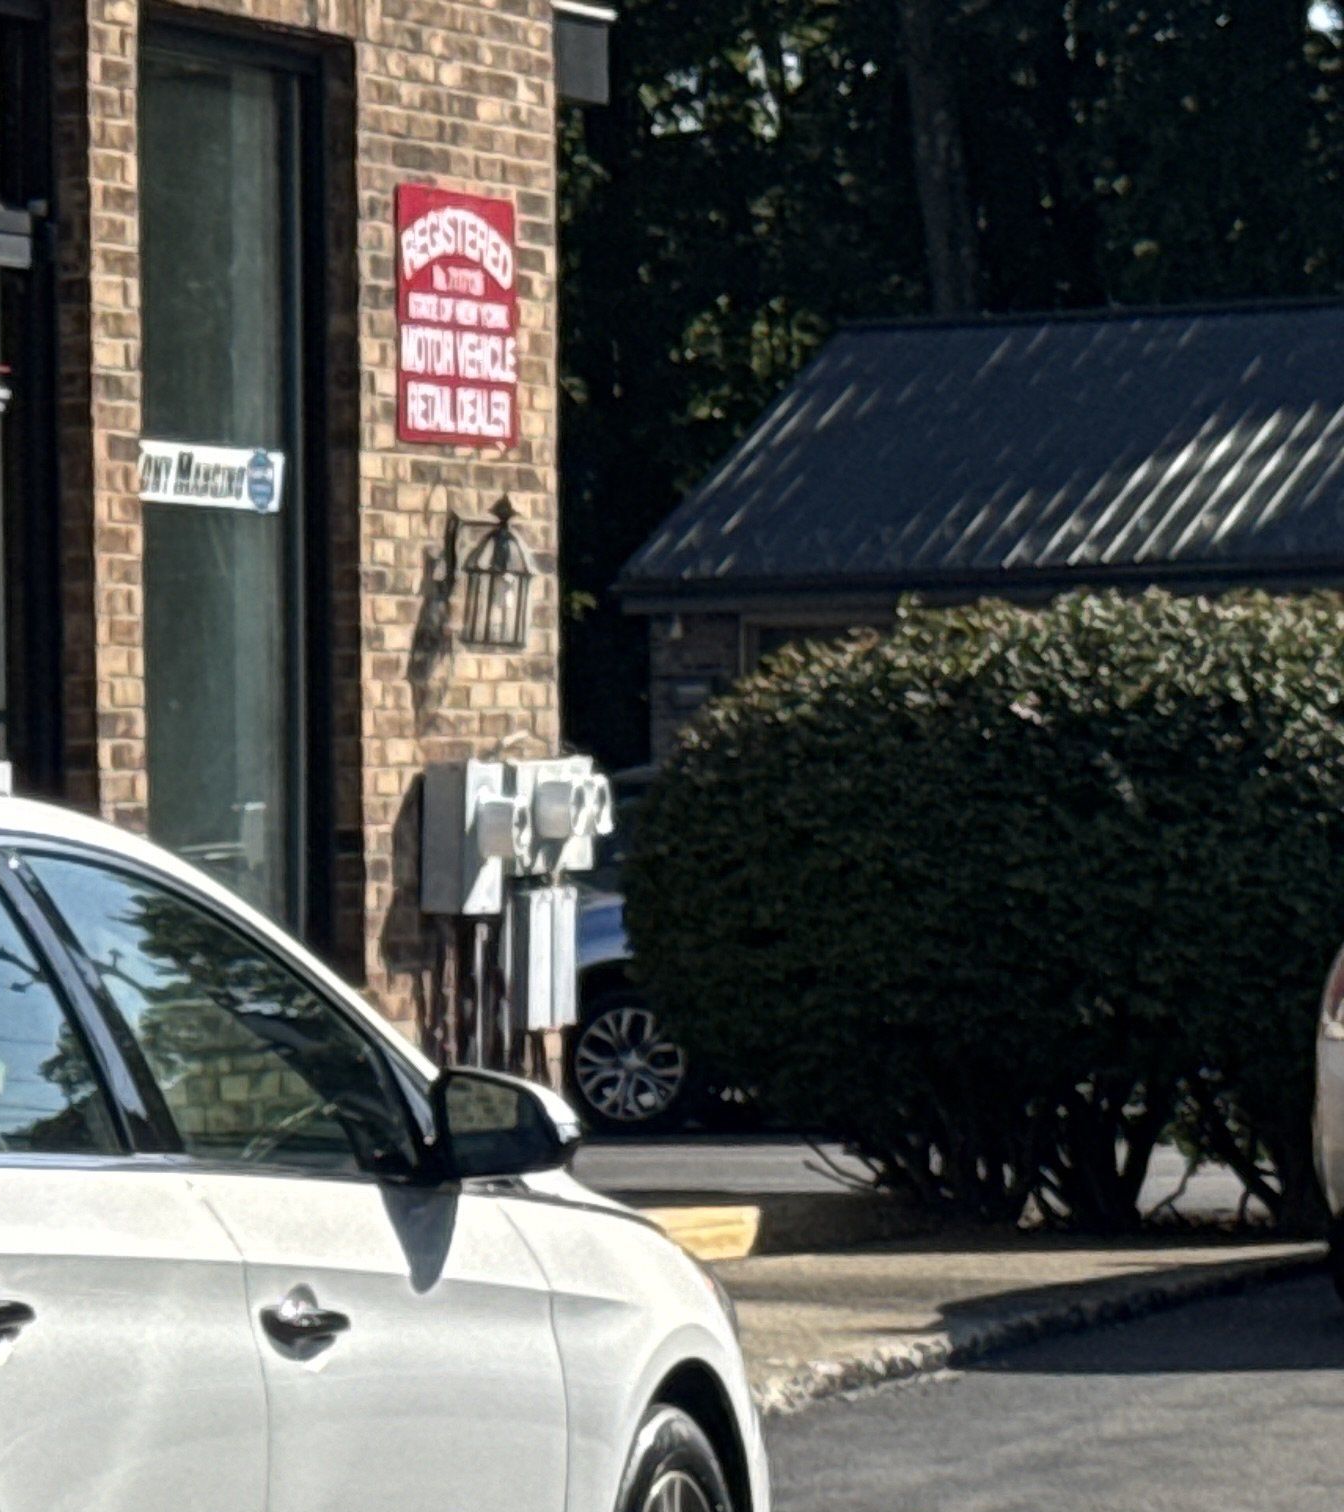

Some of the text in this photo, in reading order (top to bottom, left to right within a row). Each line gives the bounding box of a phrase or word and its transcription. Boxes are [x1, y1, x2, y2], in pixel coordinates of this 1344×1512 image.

[400, 205, 514, 290] REGISTERED
[400, 323, 517, 384] MOTOR VEHICLE
[407, 380, 512, 439] RETAIL DEALER
[140, 453, 173, 494] ONY
